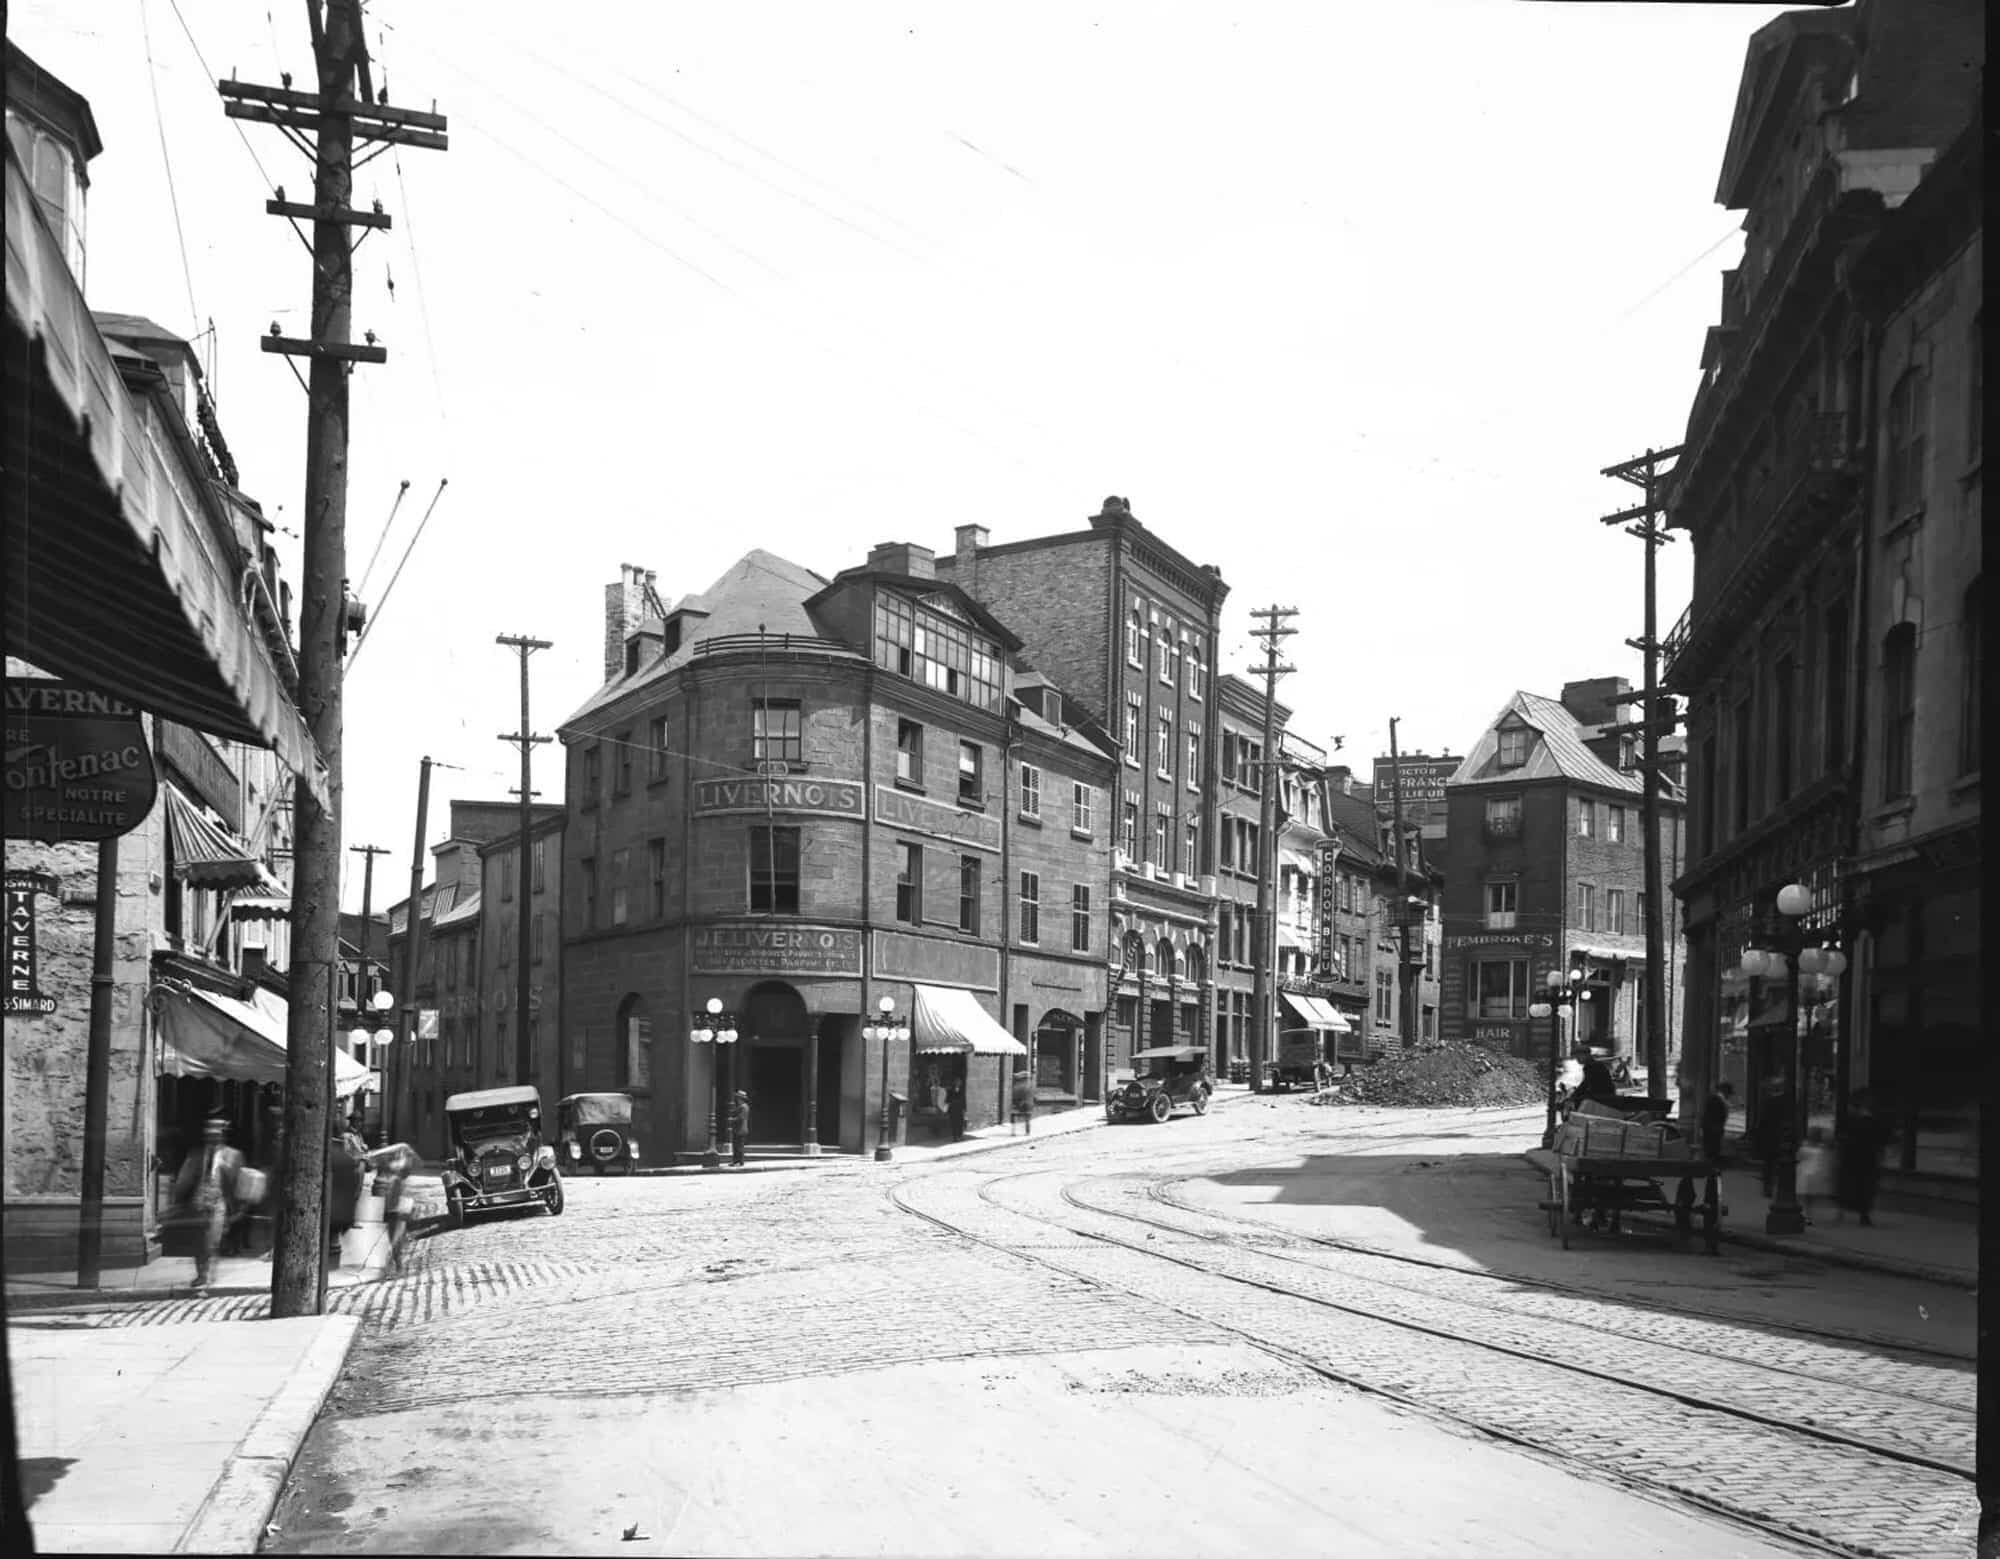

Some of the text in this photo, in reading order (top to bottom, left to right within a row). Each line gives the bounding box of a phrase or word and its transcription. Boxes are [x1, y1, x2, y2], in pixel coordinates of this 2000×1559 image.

[1398, 767, 1436, 776] ICTOR
[1380, 776, 1448, 789] LFRANC
[65, 787, 127, 803] NOTRE
[699, 783, 855, 809] LIVERNOIS
[1322, 851, 1333, 971] CORDON BLEU
[11, 891, 31, 991] TAVERNE
[1475, 1027, 1510, 1039] HAIR
